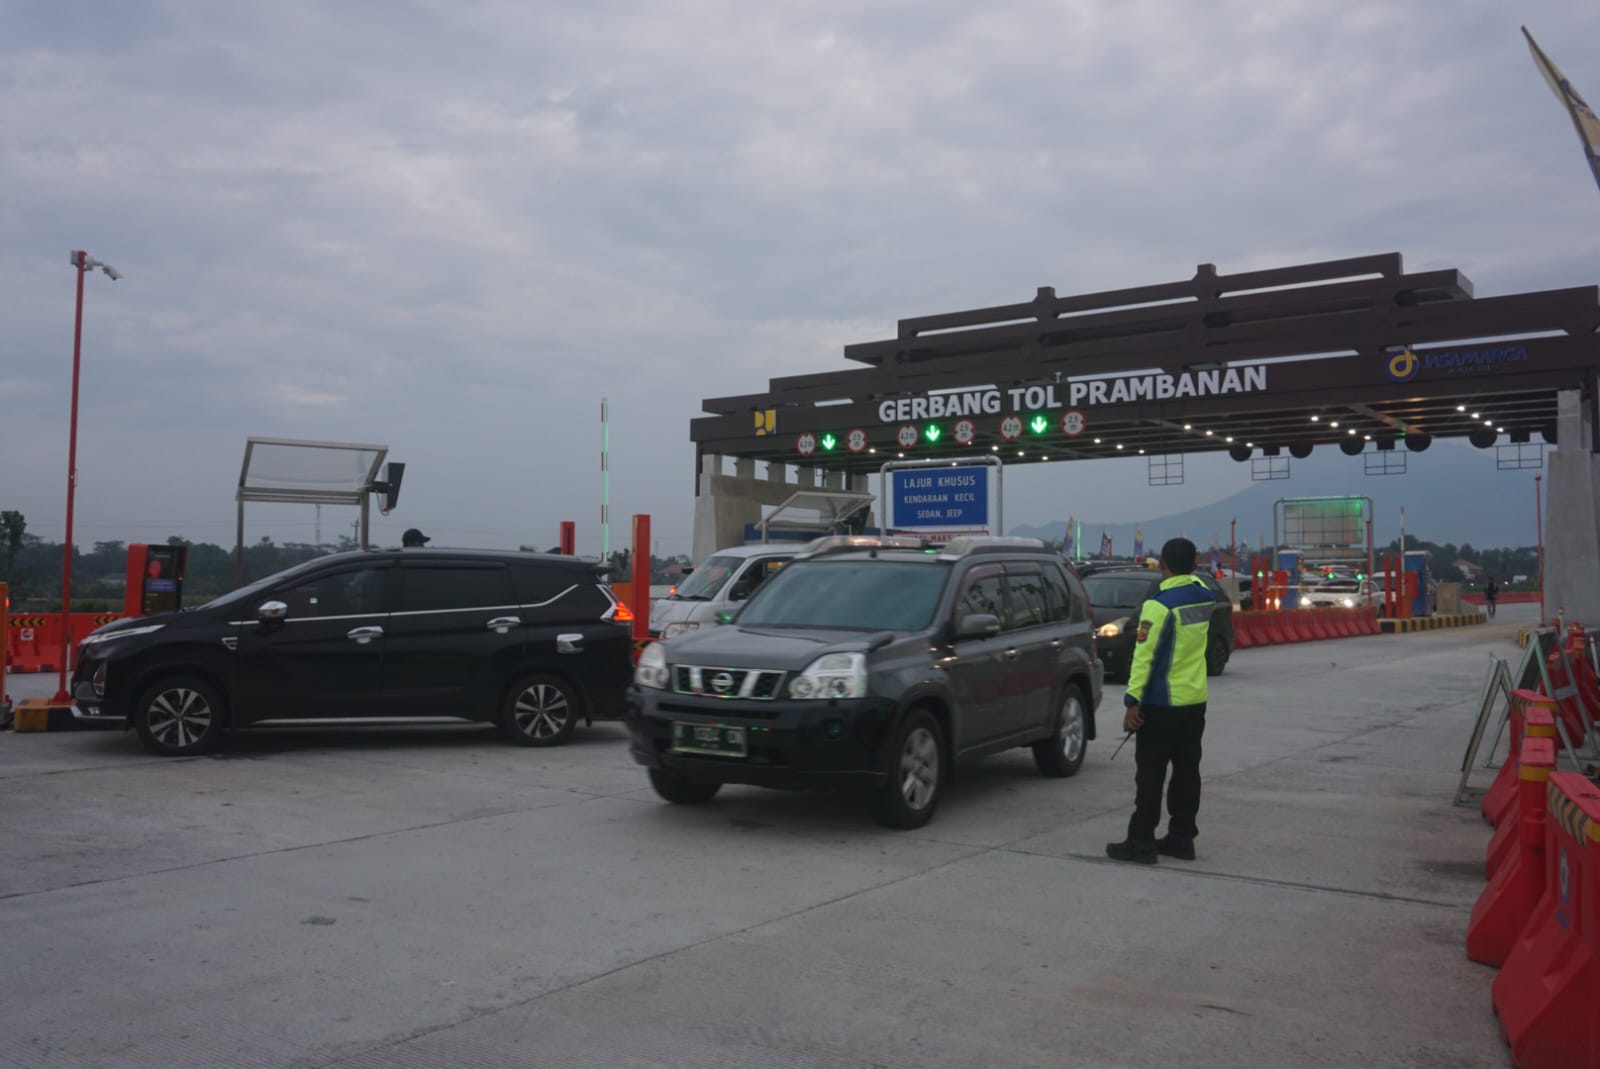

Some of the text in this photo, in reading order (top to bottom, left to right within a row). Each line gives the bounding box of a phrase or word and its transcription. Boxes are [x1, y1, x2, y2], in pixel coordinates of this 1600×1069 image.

[879, 365, 1267, 423] GERBANG TOL PRAMBANAN
[904, 475, 976, 489] LAJUR KHUSUS
[904, 492, 975, 504] KENDARAAN KECIL
[946, 508, 963, 518] JEEP
